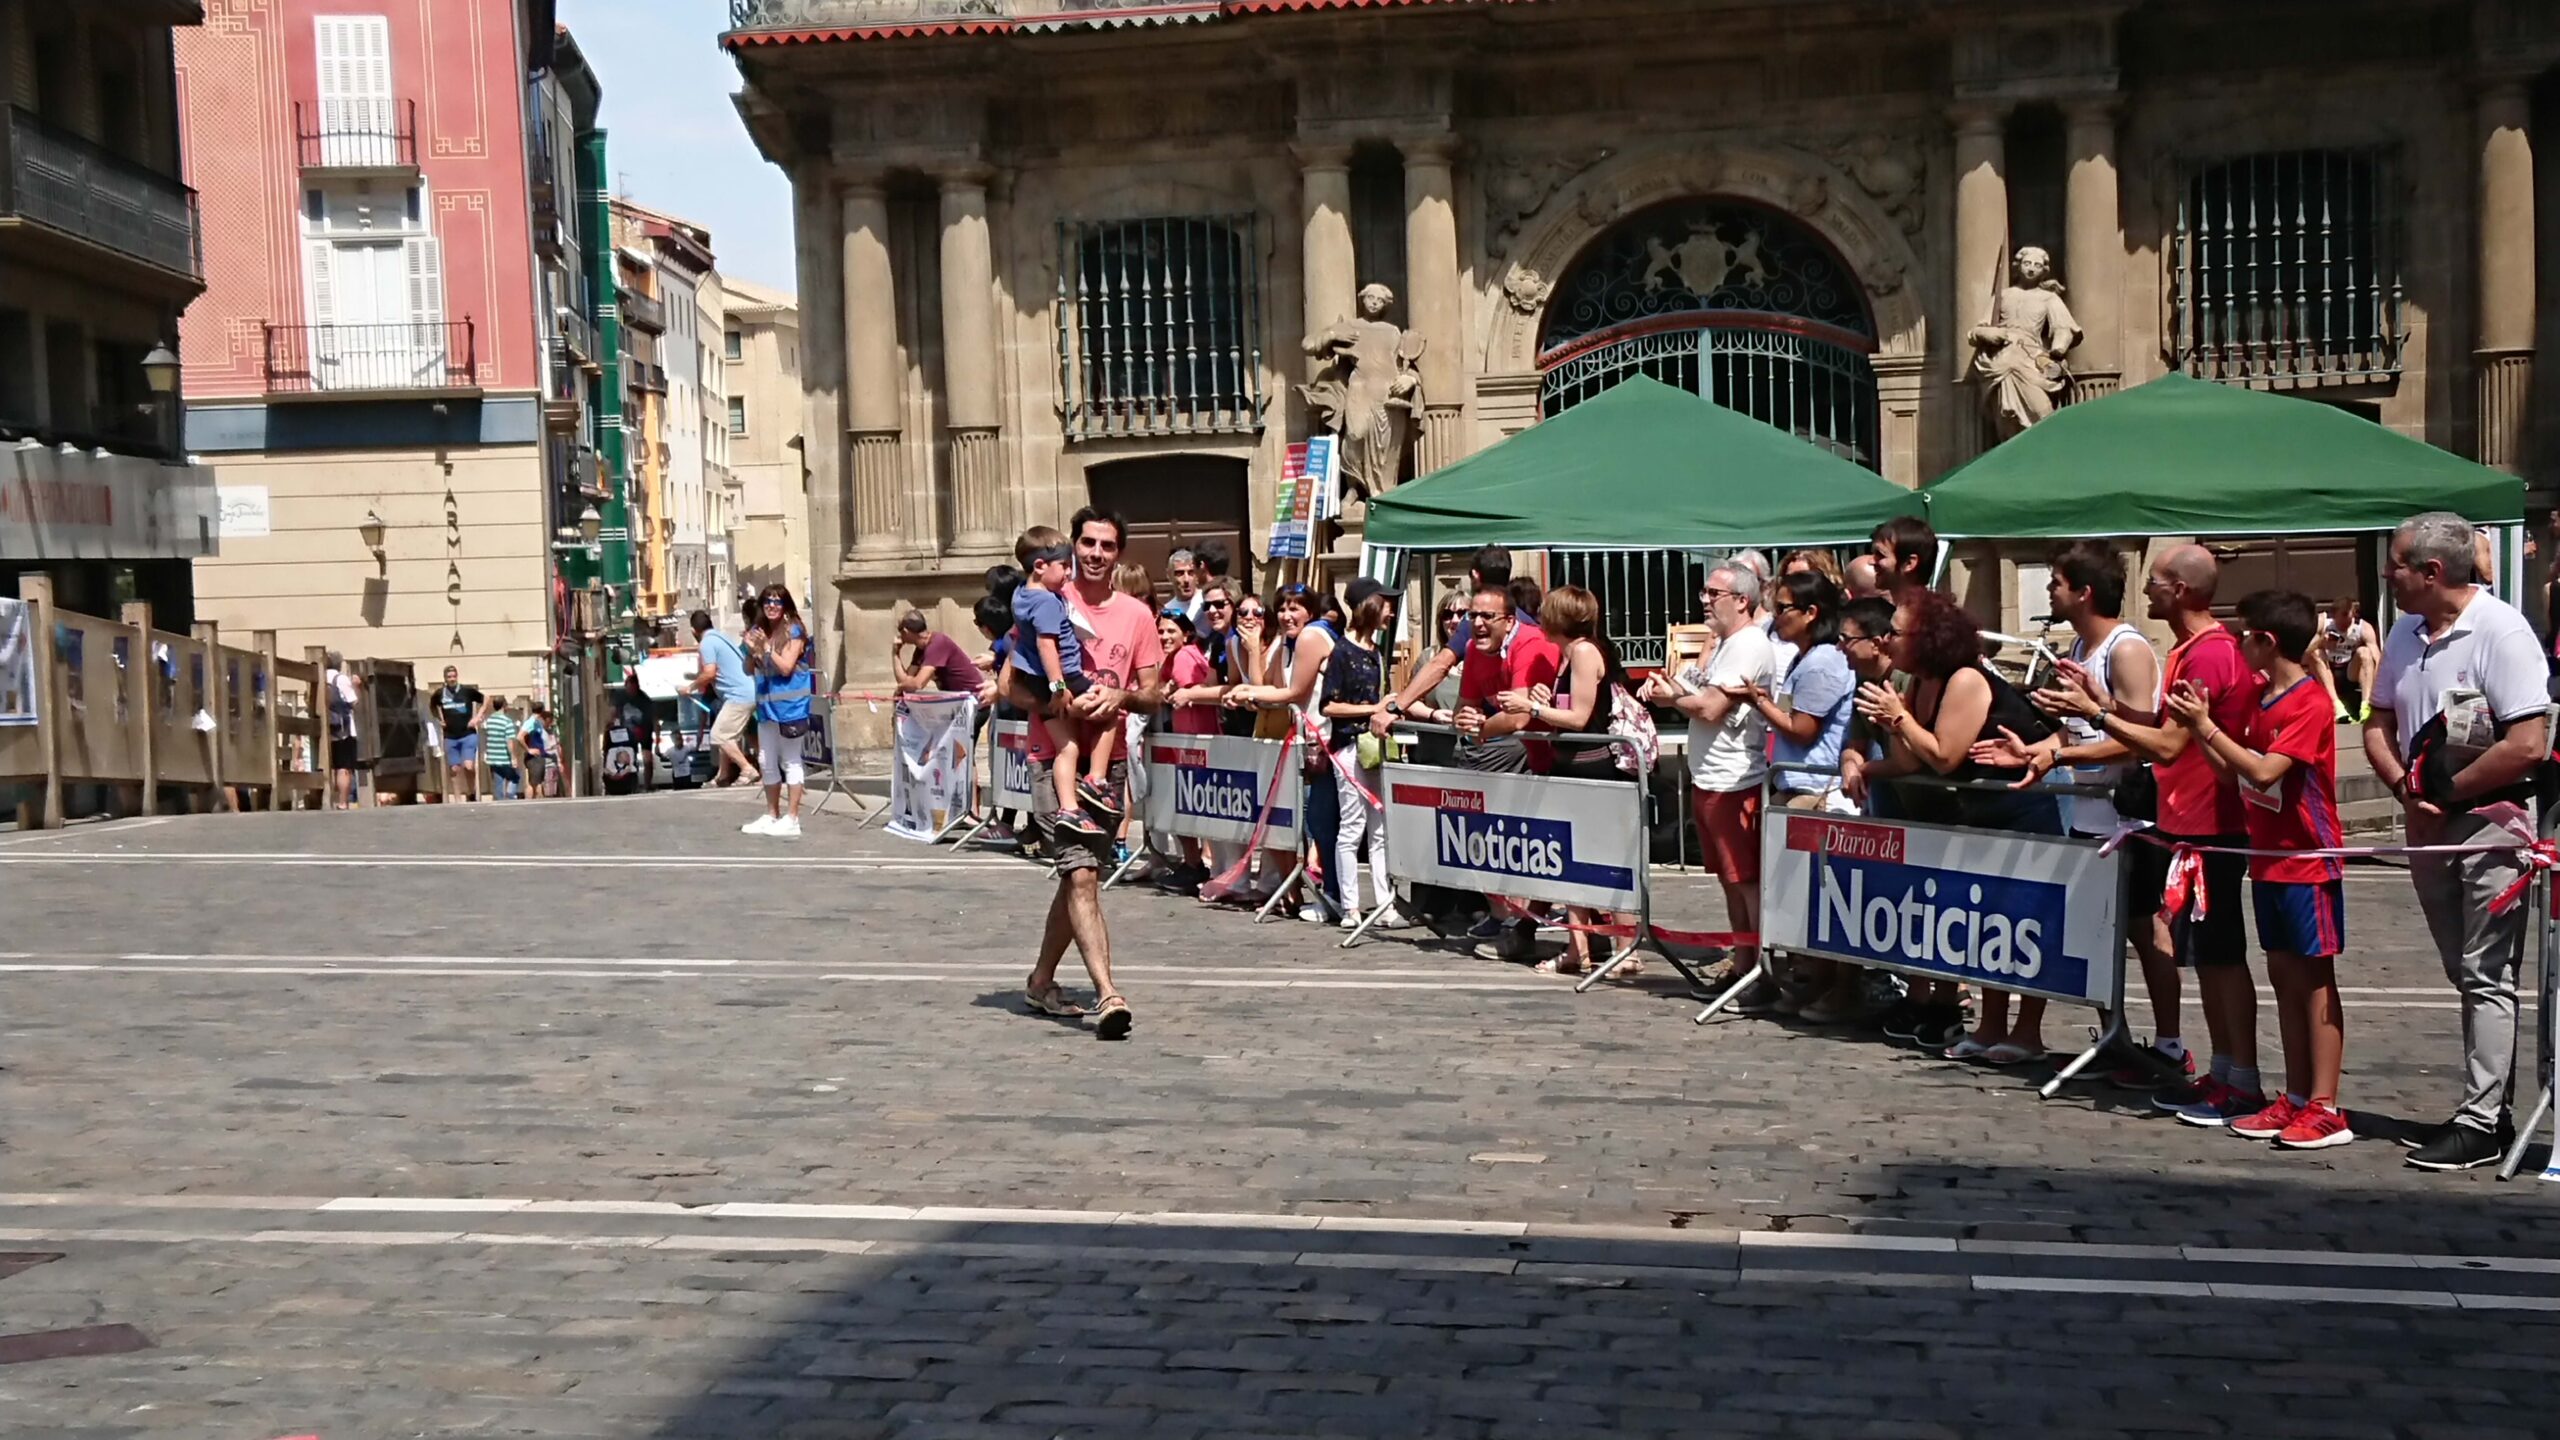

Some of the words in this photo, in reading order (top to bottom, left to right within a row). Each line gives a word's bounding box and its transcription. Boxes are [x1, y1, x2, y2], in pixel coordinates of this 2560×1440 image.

[443, 462, 465, 653] FARMACIA
[1177, 769, 1252, 819] Noticias
[1441, 790, 1470, 808] Diario
[1471, 793, 1482, 810] de
[1440, 814, 1563, 877] Noticias
[1825, 825, 1876, 856] Diario
[1880, 831, 1900, 859] de
[1818, 864, 2042, 979] Noticias
